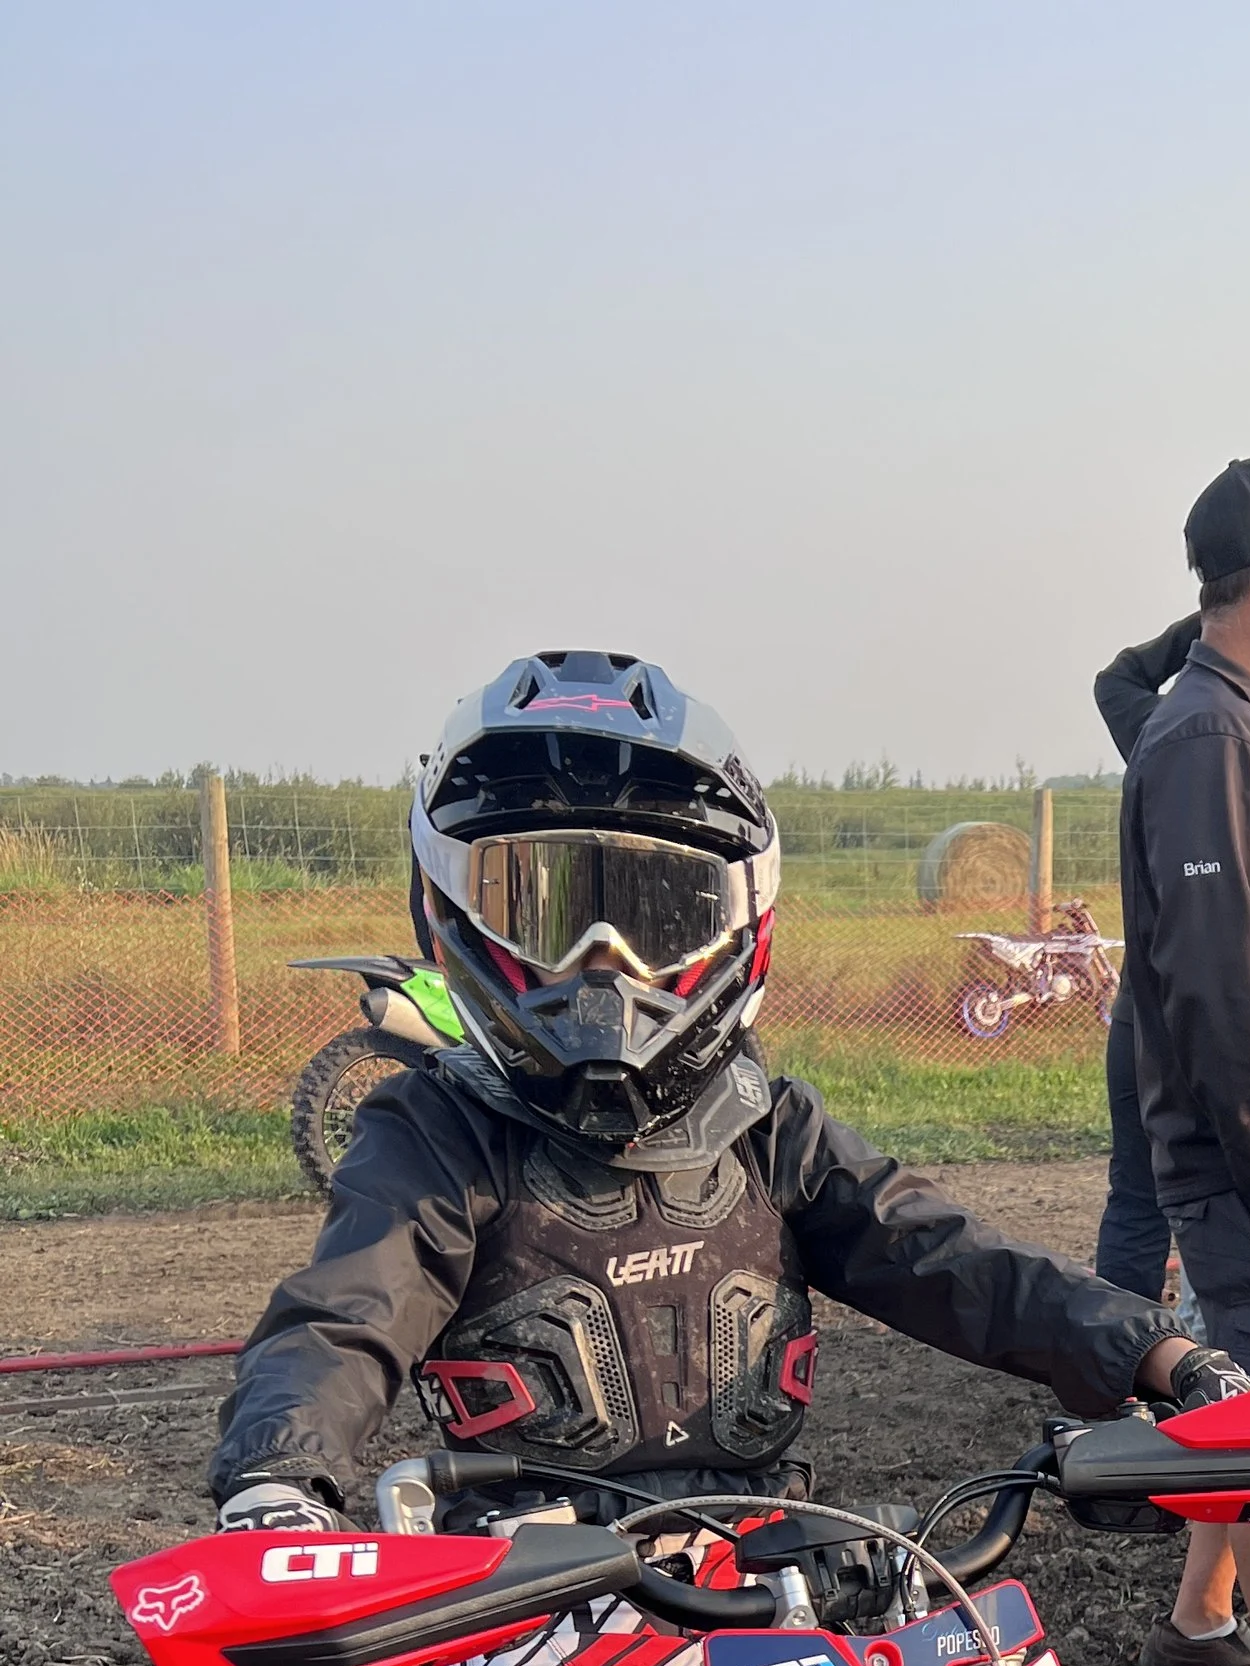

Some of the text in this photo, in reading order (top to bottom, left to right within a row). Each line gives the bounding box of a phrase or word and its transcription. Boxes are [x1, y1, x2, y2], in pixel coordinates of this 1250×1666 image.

[1183, 860, 1221, 877] Brian
[606, 1240, 704, 1288] LEATT
[937, 1626, 1000, 1657] POPESO
